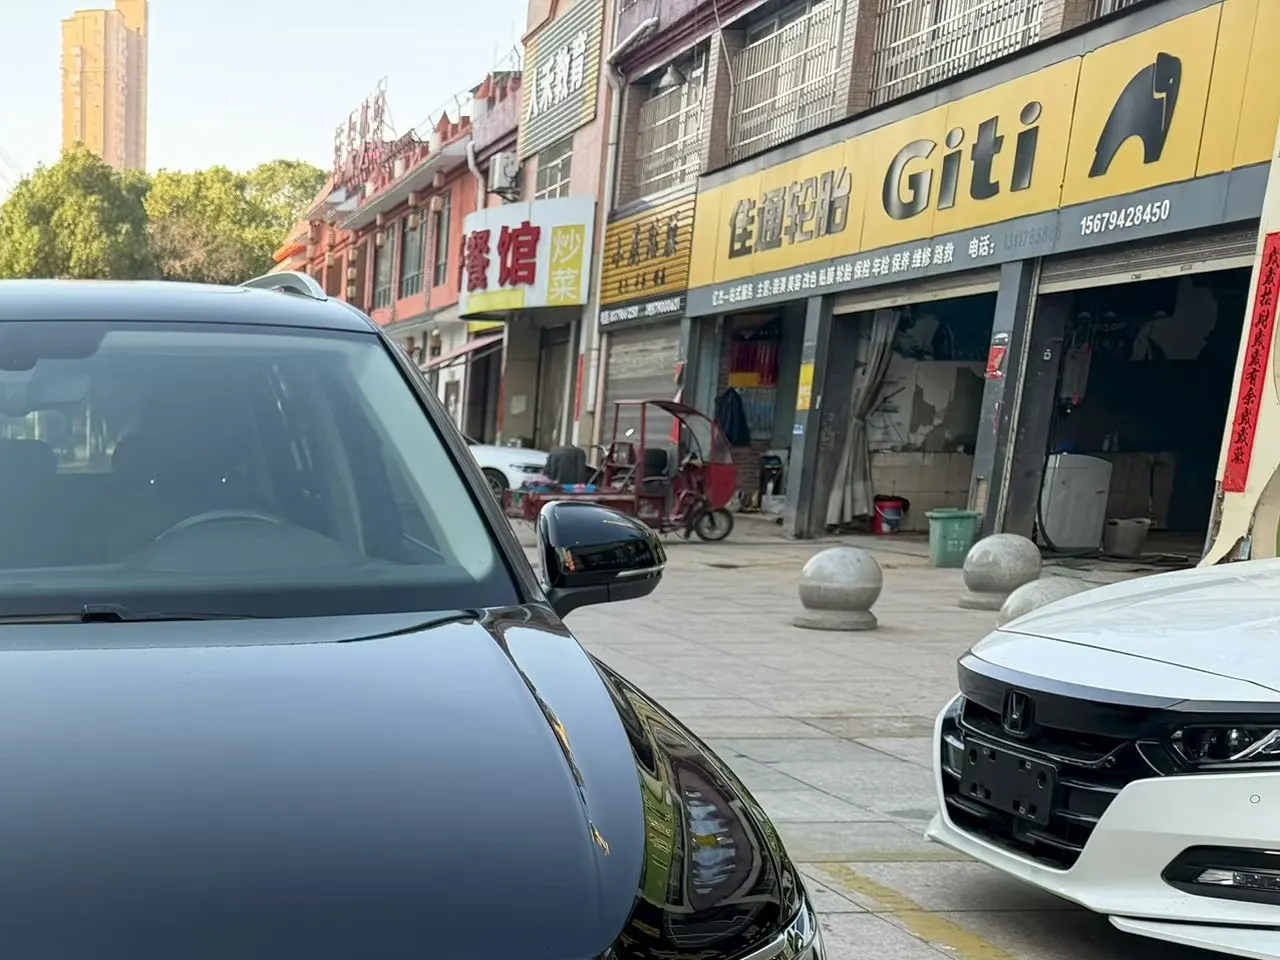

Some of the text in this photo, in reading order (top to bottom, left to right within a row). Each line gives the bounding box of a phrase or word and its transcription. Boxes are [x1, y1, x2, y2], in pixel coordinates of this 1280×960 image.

[728, 166, 853, 259] 佳通轮胎
[883, 101, 1042, 220] Giti
[549, 228, 581, 301] 炒菜
[892, 252, 911, 273] 保养
[912, 247, 932, 268] 维修
[933, 242, 955, 264] 路救
[1080, 199, 1171, 236] 15679428450
